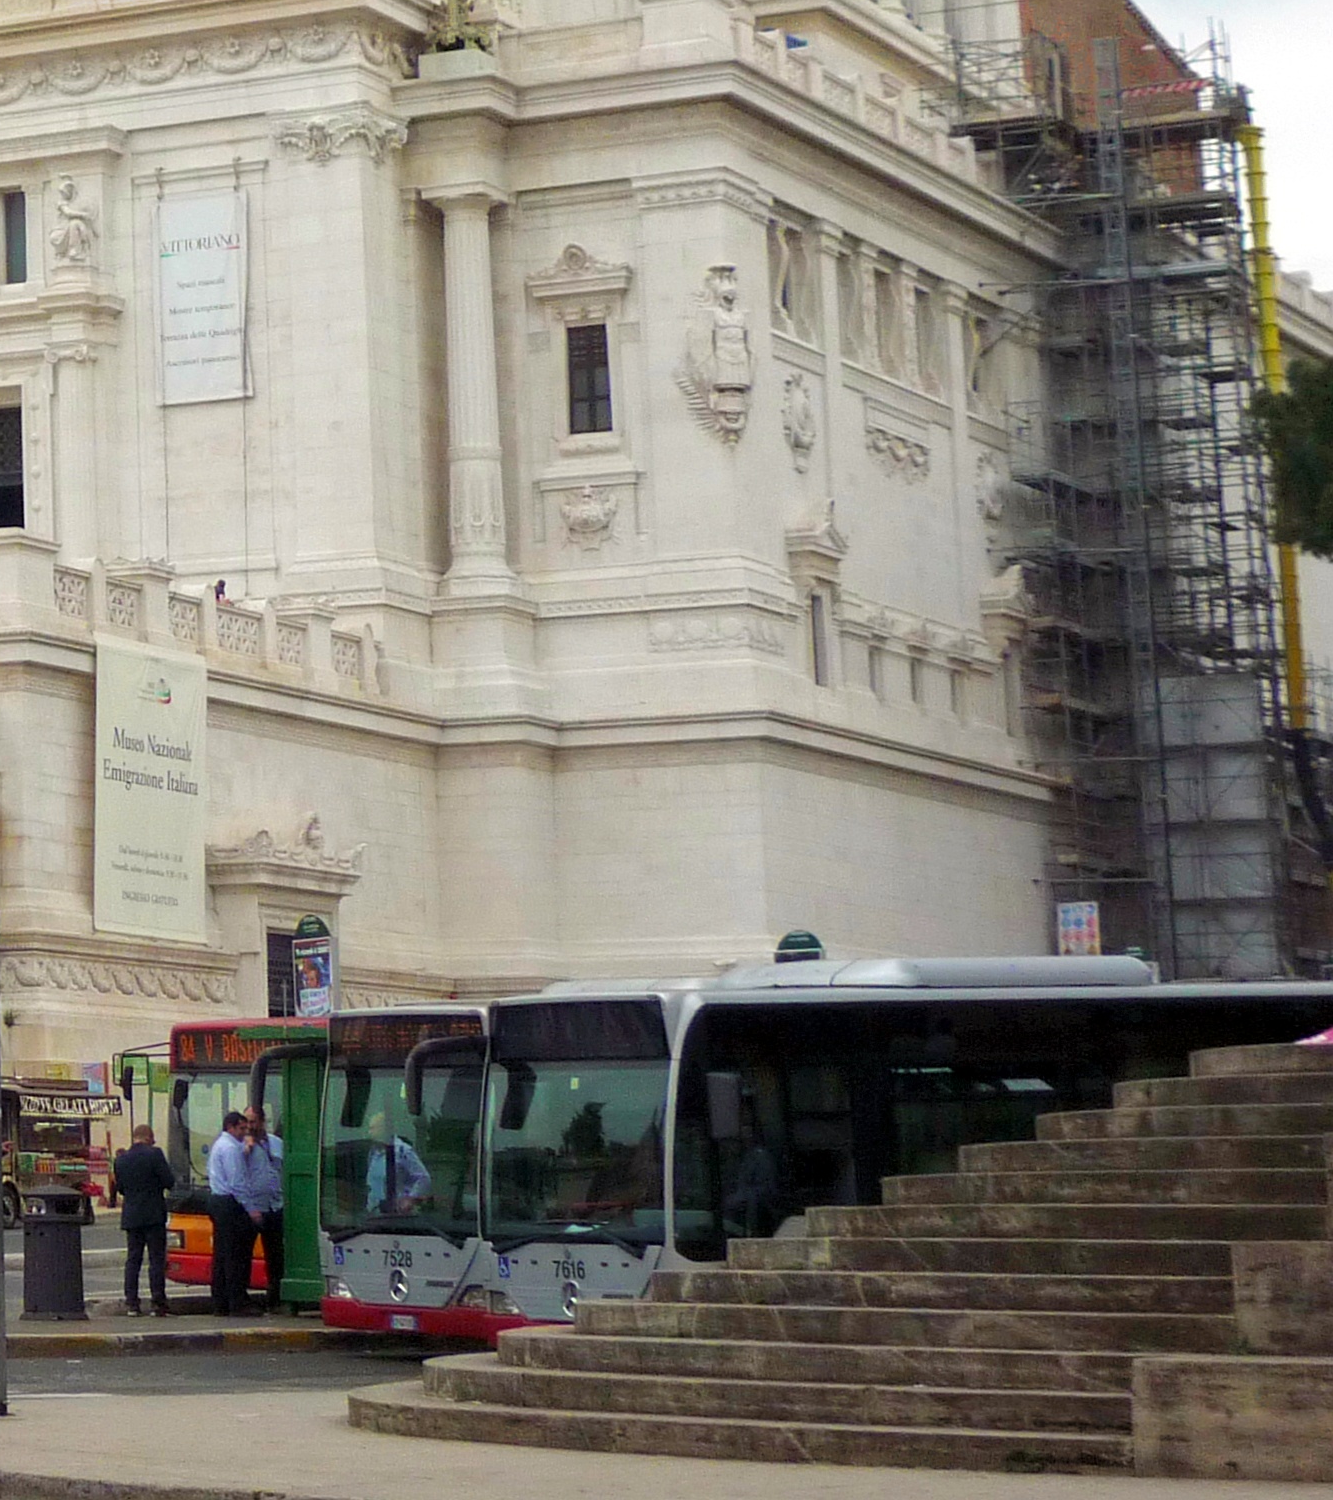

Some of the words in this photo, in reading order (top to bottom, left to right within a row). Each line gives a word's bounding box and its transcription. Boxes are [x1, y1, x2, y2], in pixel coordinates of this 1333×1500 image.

[112, 726, 145, 753] Museo
[148, 733, 192, 762] Nazionale
[103, 758, 164, 791] Emigrazione
[166, 770, 199, 796] Italiana
[383, 1249, 413, 1268] 7528
[552, 1260, 586, 1280] 7616
